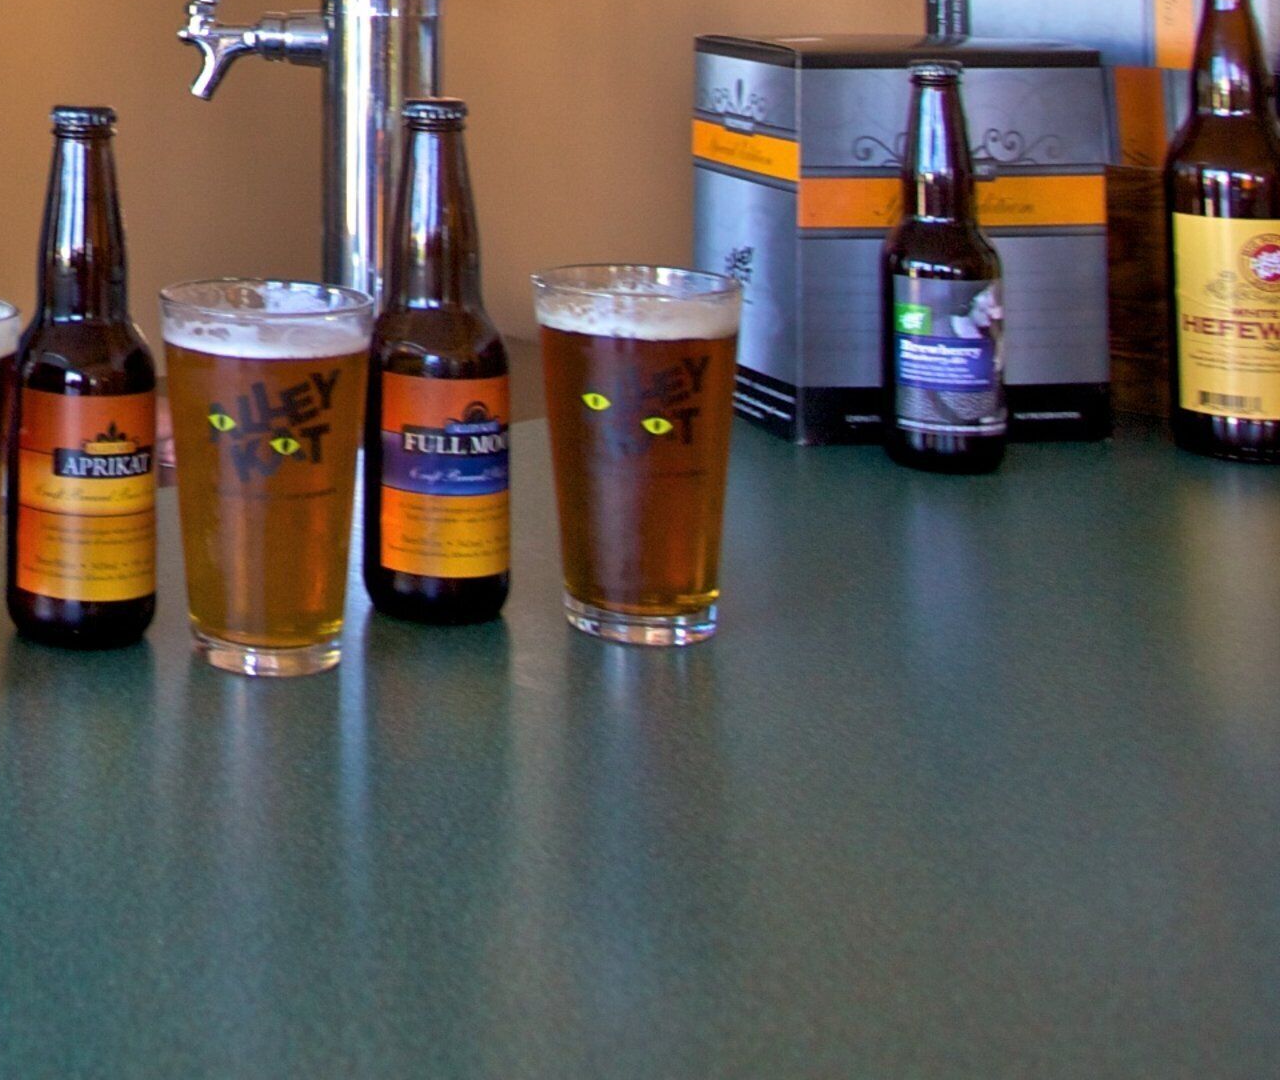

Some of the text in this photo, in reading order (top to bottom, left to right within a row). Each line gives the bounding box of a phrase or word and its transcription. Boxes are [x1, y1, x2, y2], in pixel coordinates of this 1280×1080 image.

[1181, 314, 1280, 340] HEFEW
[208, 370, 341, 444] ALLEY
[231, 423, 332, 484] KAT
[404, 431, 468, 455] FULL
[61, 453, 150, 477] APRIKAT
